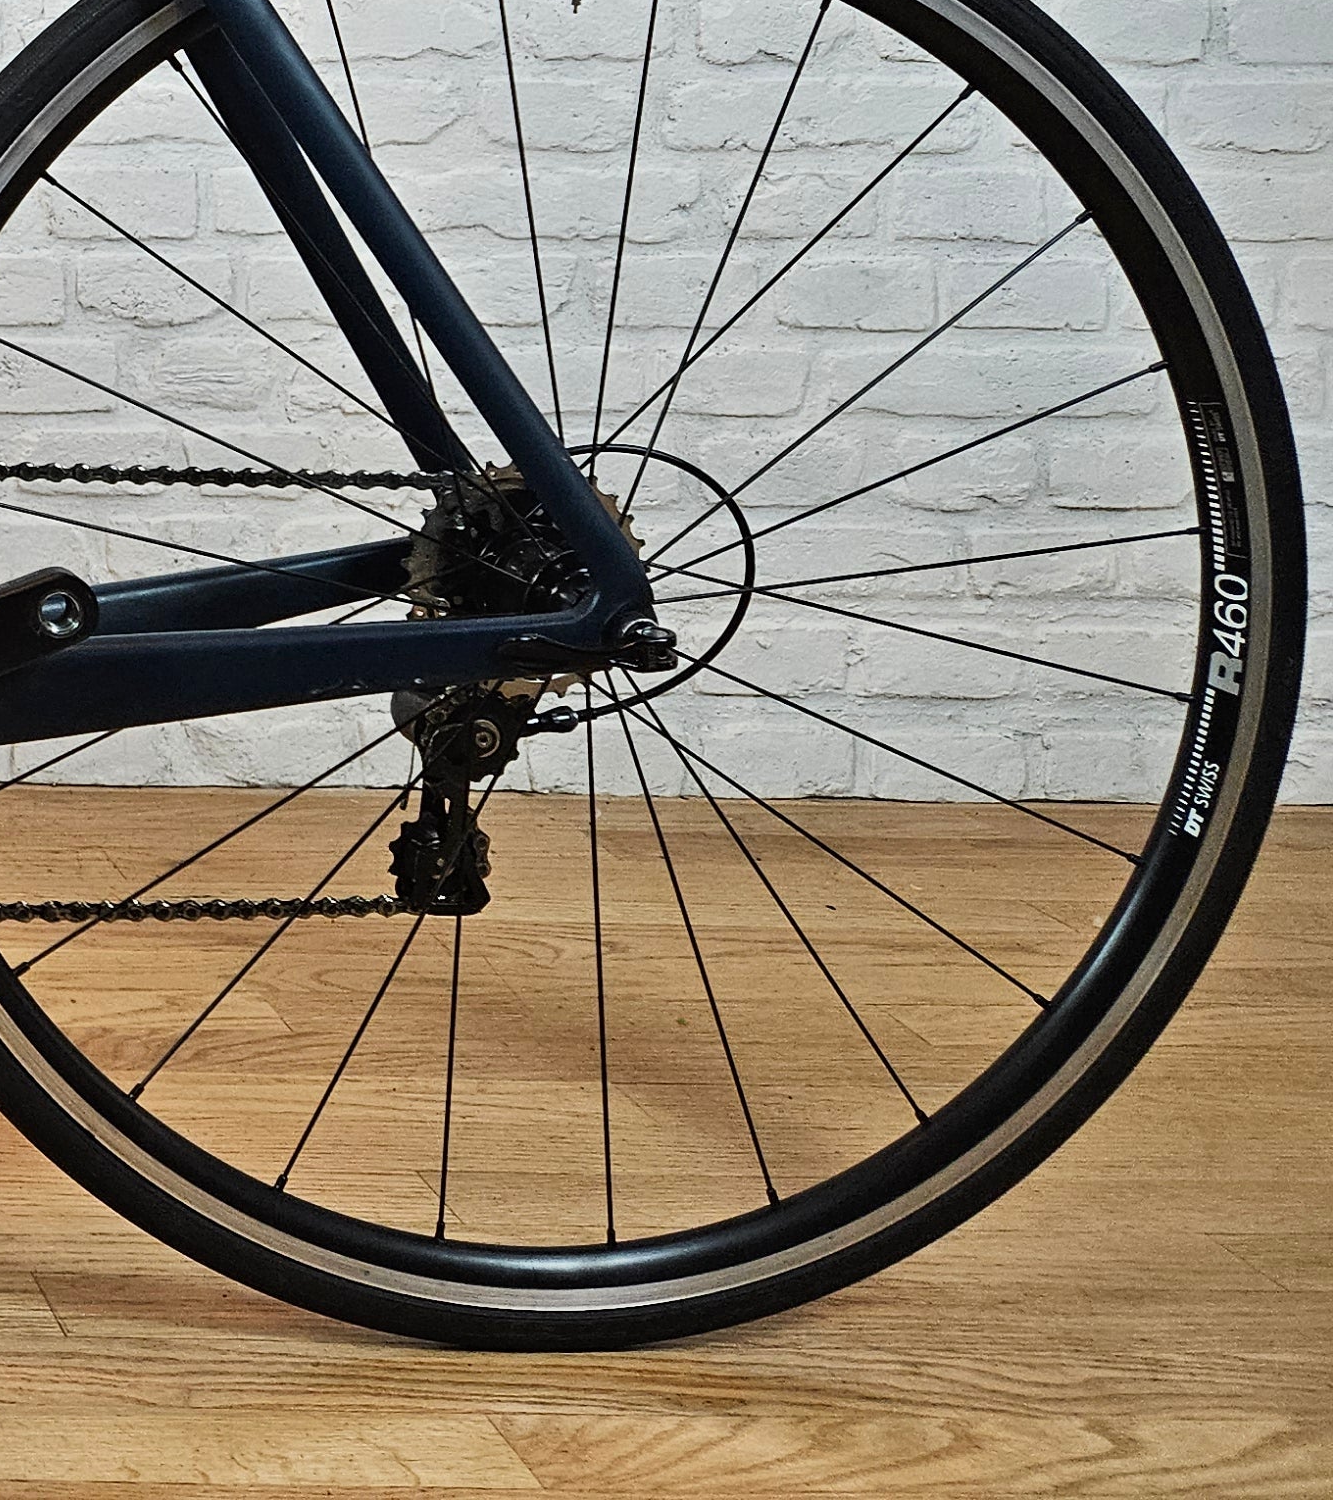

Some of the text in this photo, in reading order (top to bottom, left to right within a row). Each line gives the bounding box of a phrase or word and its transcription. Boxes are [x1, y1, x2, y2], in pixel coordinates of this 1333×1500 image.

[1208, 574, 1248, 696] R460
[1184, 760, 1220, 838] DT SWISS
